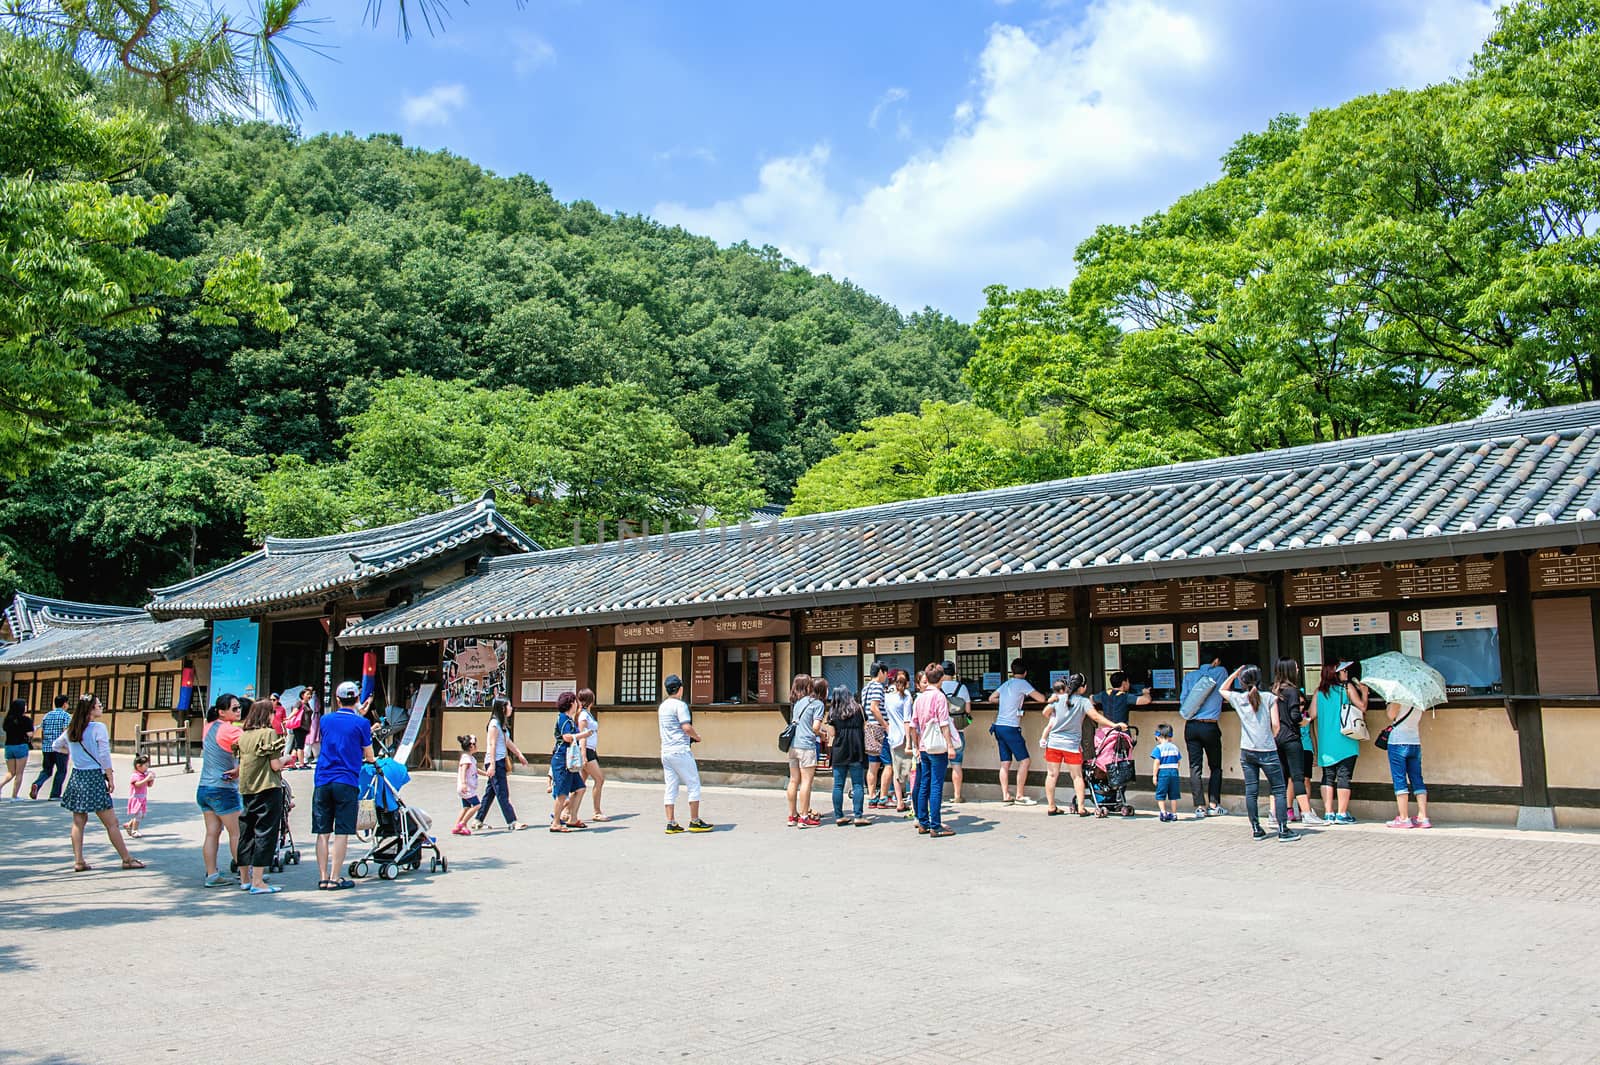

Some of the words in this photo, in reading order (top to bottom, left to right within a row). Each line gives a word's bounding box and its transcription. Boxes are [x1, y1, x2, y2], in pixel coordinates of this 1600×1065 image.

[1406, 612, 1420, 622] 08
[1308, 618, 1320, 628] 07
[1109, 628, 1119, 637] 05
[1187, 625, 1198, 634] 06
